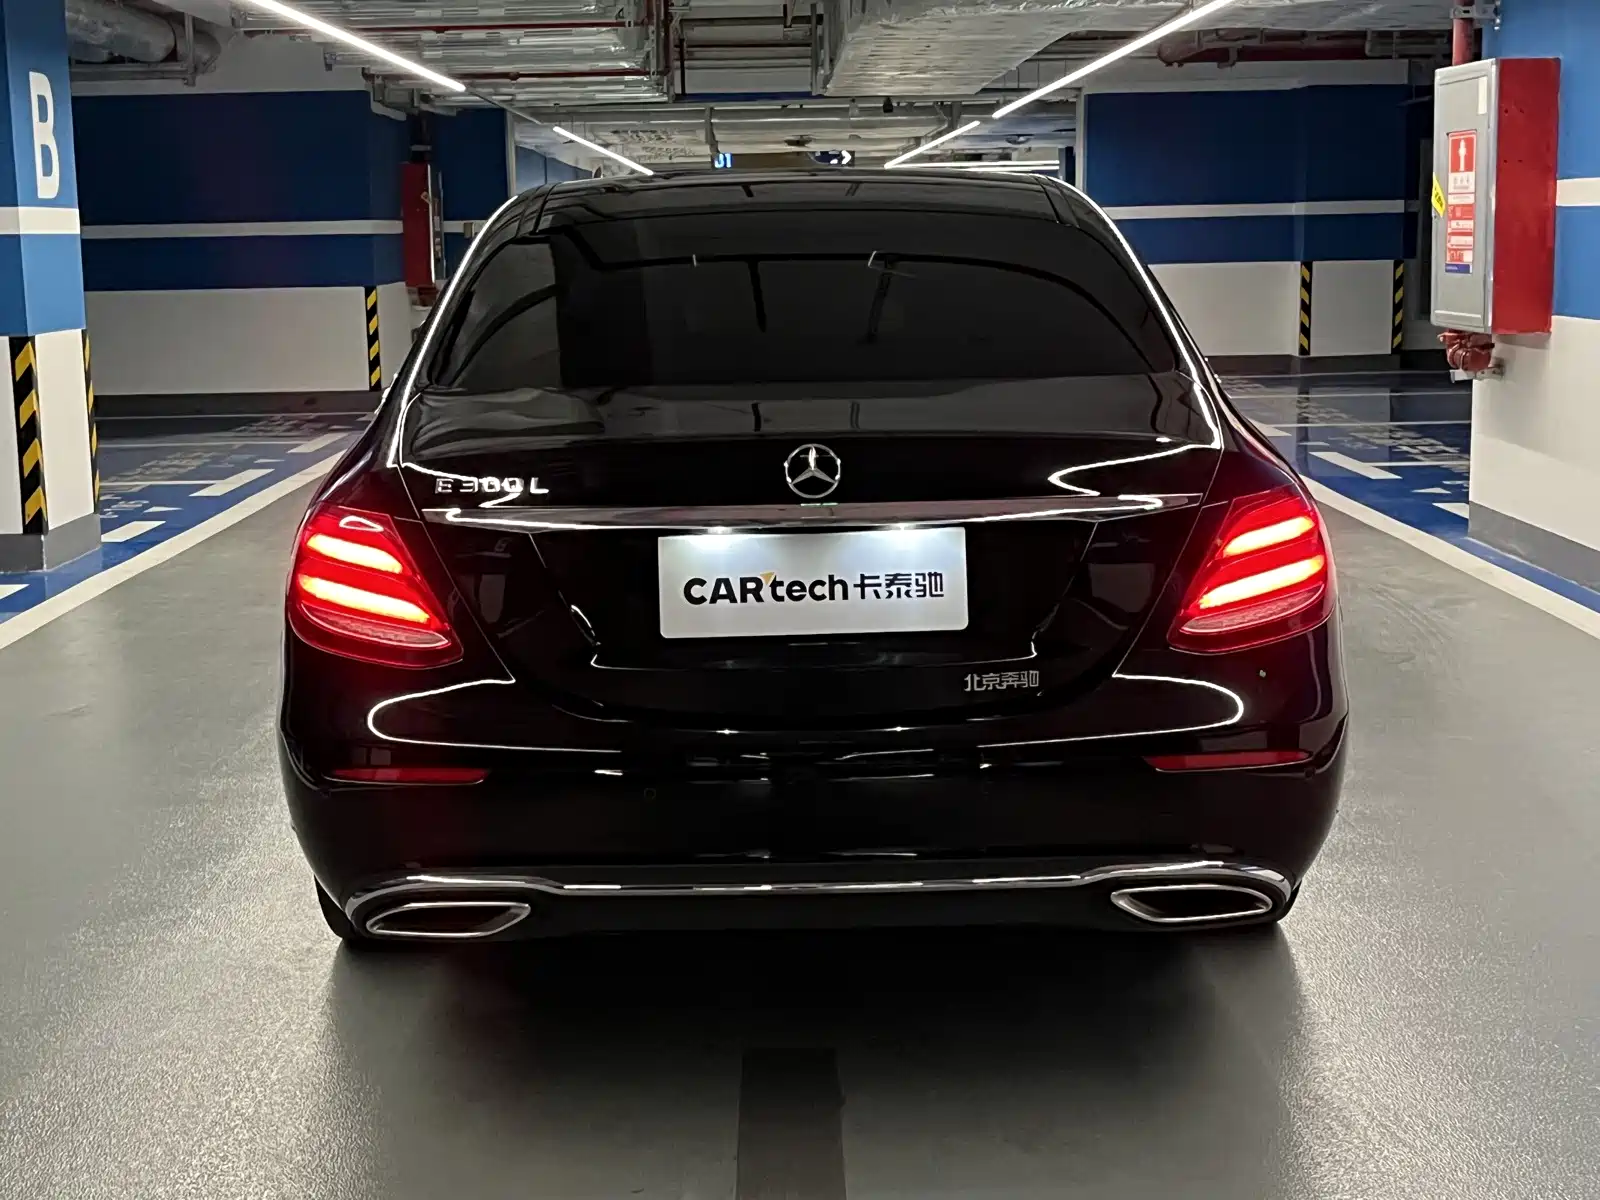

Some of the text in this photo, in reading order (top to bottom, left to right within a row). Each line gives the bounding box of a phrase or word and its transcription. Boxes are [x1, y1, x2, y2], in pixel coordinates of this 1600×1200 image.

[29, 71, 60, 199] B
[853, 571, 945, 600] 卡泰驰
[963, 670, 1040, 692] 北京奔驰
